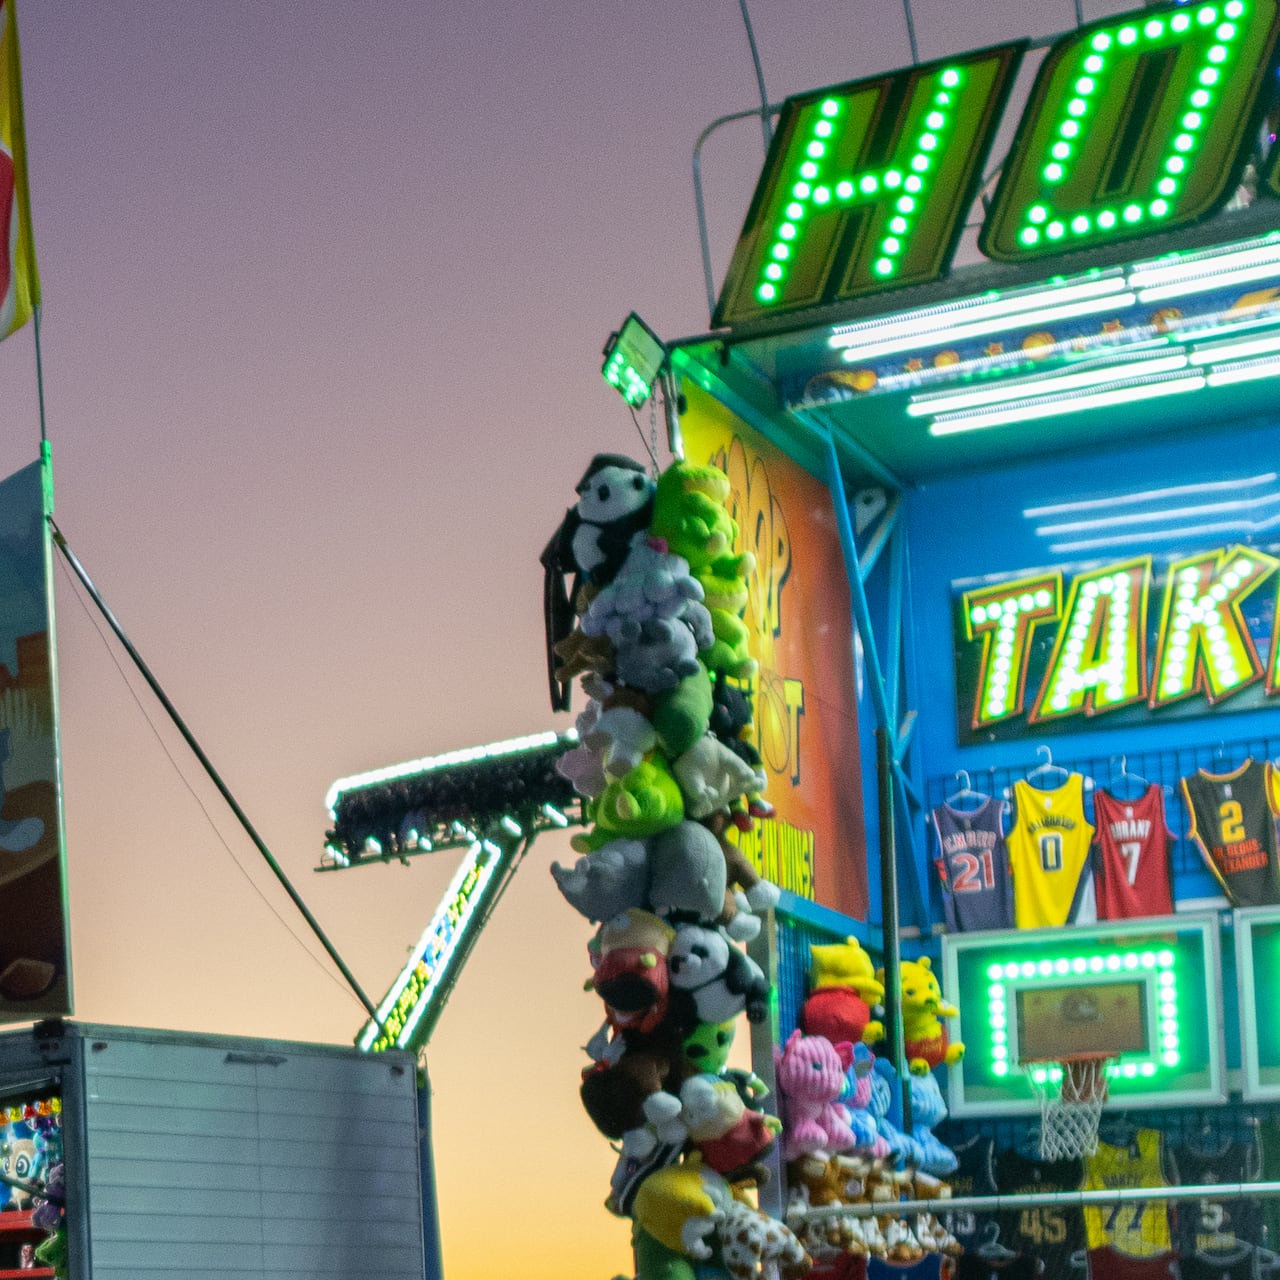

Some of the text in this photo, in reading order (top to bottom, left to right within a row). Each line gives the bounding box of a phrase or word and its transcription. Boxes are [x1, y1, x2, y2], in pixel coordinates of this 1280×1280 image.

[714, 0, 1280, 330] HO
[962, 543, 1280, 728] TAK
[1219, 800, 1246, 844] 2
[952, 849, 996, 893] 21
[1039, 831, 1064, 874] 0
[1120, 841, 1141, 886] 7
[1020, 1207, 1067, 1245] 45
